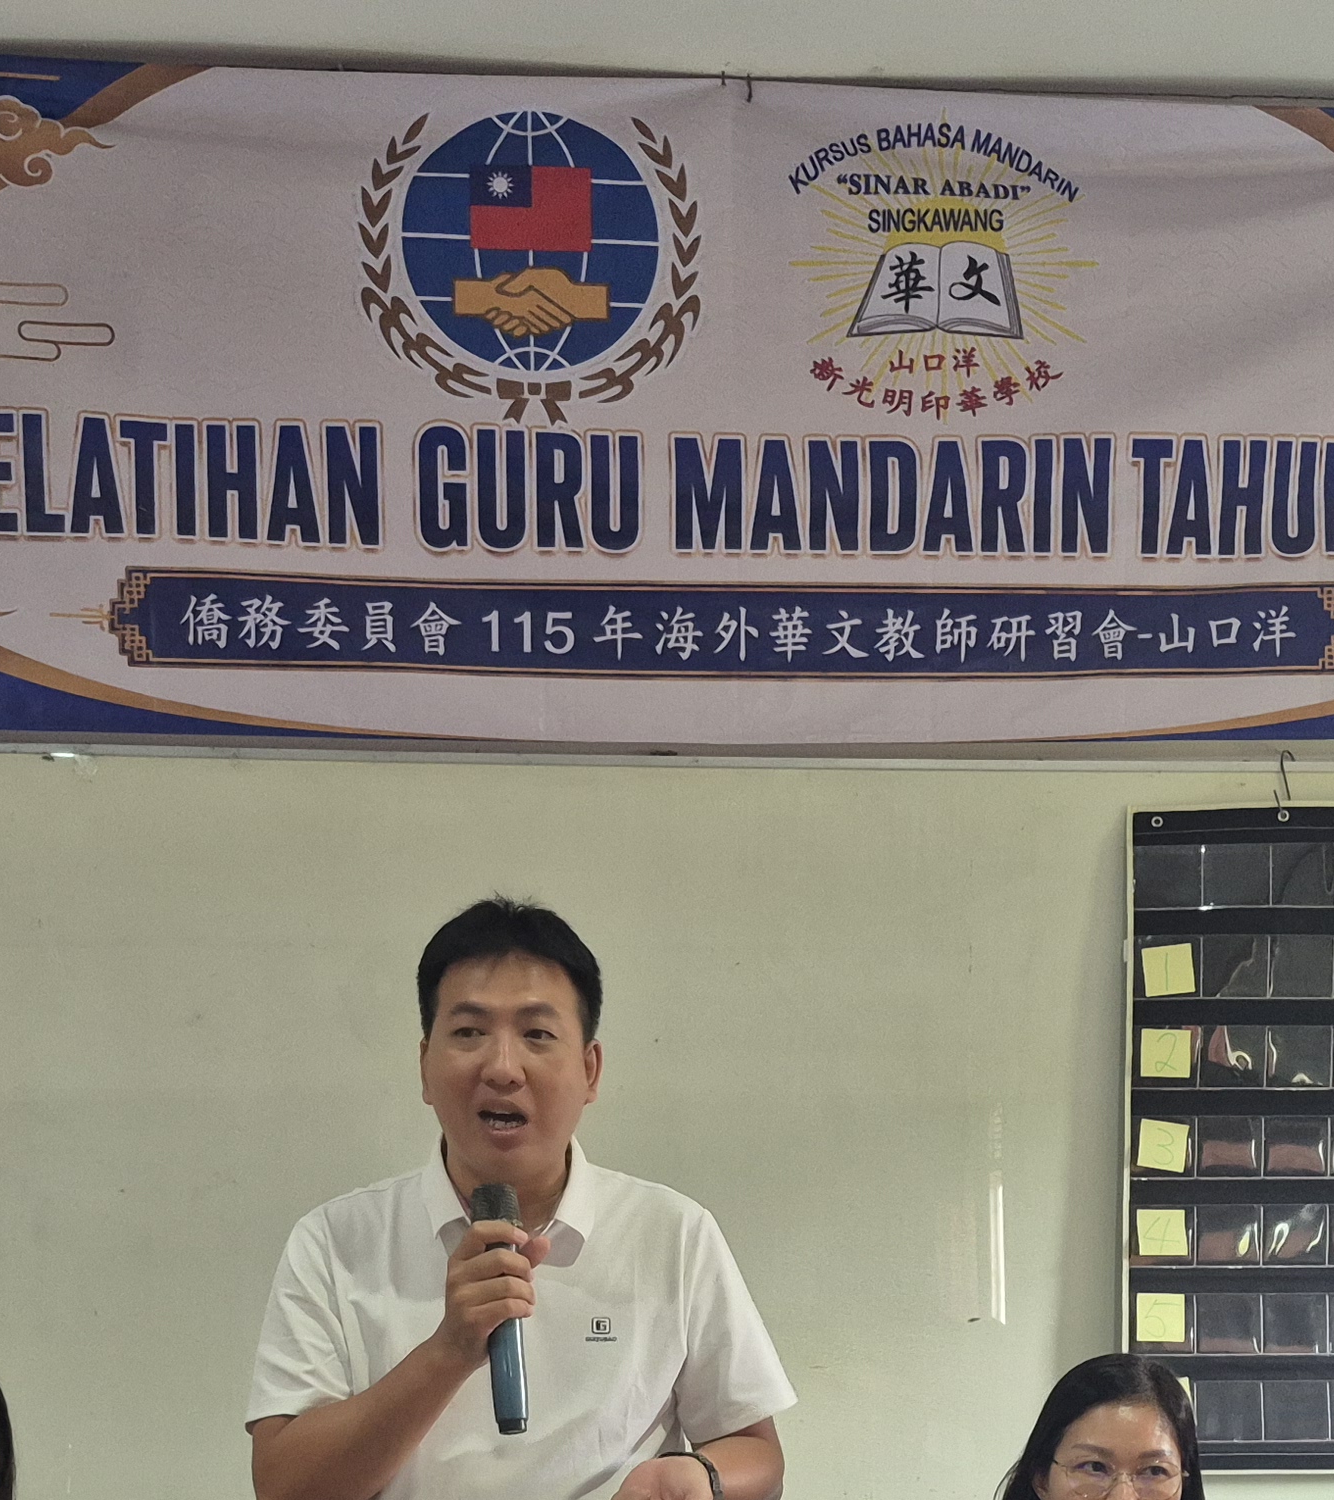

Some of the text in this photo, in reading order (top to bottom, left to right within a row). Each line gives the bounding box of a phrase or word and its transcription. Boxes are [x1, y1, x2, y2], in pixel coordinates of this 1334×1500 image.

[788, 123, 1079, 202] KURSUS BAHASA MANDARIN
[867, 208, 1004, 232] SINGKAWANG
[888, 347, 981, 378] 山口洋
[418, 424, 639, 552] GURU
[674, 435, 1112, 556] MANDARIN
[1154, 1032, 1178, 1073] 2
[1153, 1127, 1175, 1165] 3
[1142, 1216, 1181, 1253] 4
[1144, 1299, 1182, 1338] 5
